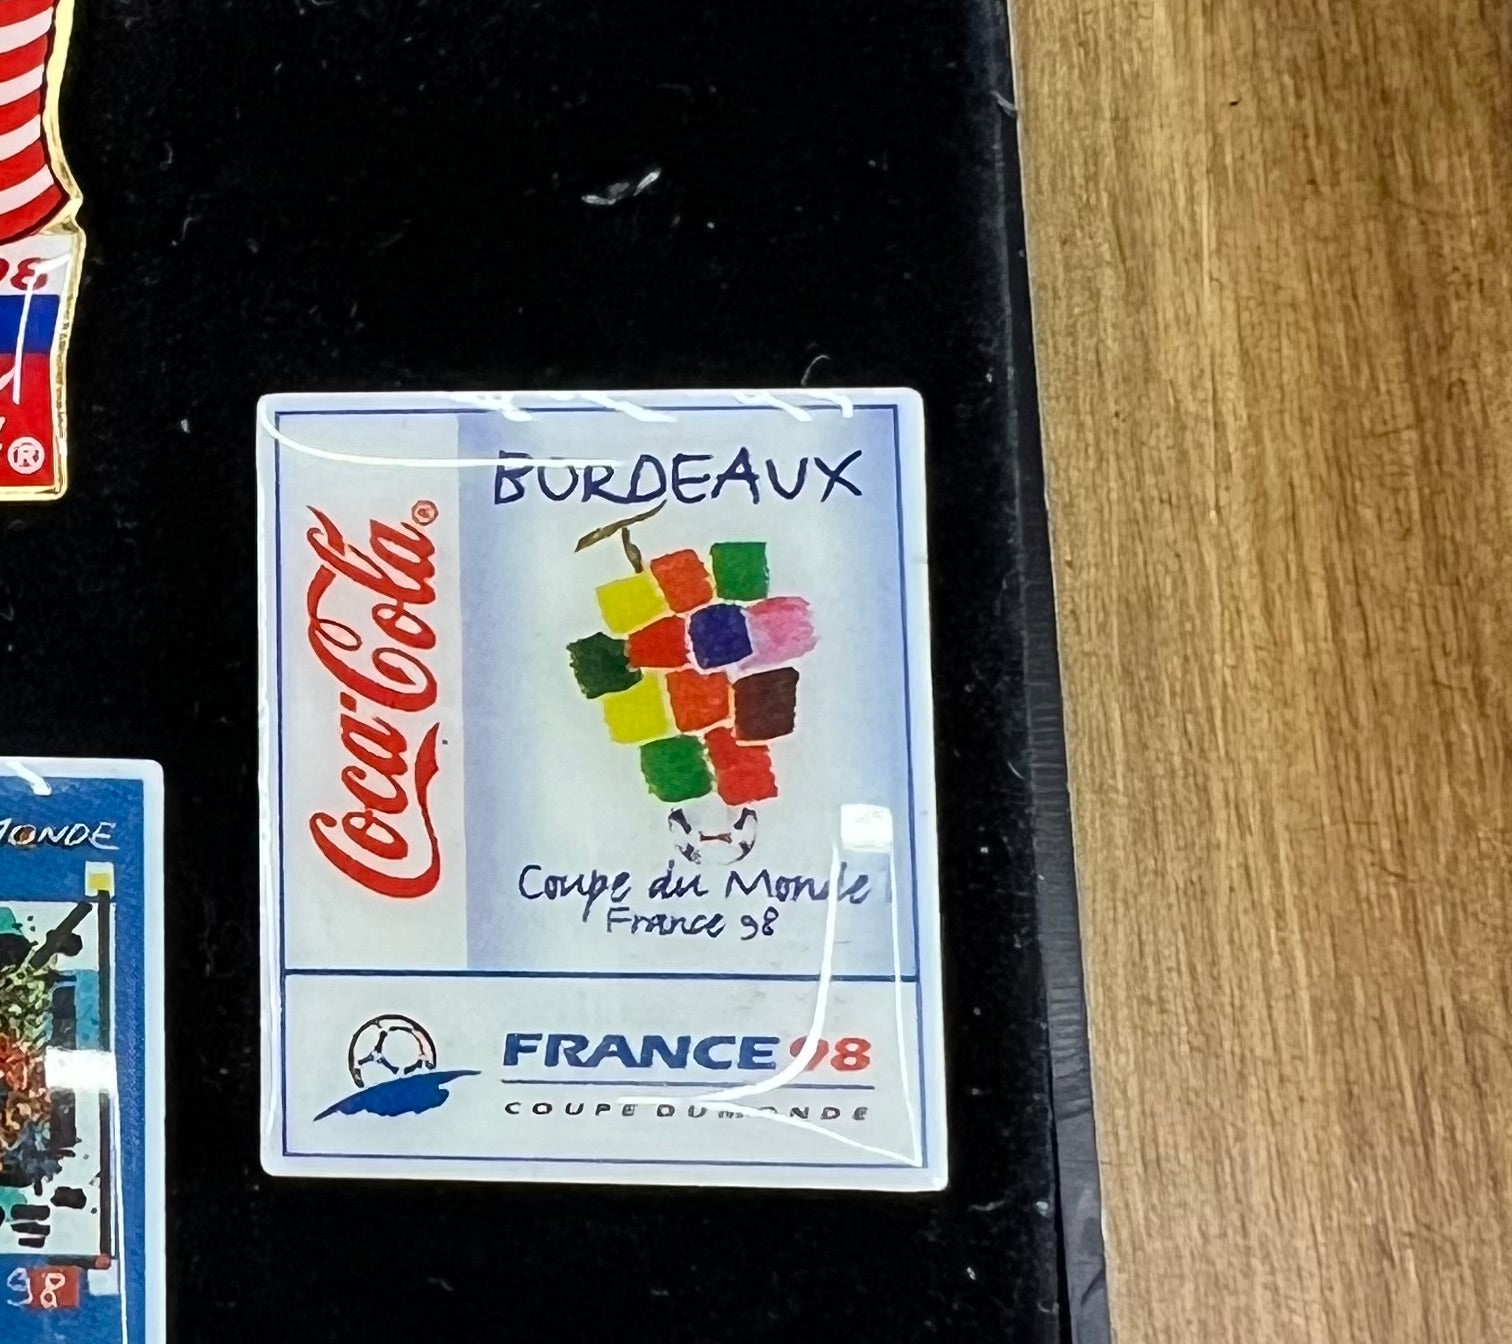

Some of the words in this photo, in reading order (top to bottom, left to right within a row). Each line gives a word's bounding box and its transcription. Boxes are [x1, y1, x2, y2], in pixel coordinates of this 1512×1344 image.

[494, 447, 863, 506] BORDEAUX
[518, 864, 632, 922] Coupe
[647, 859, 709, 900] du
[606, 906, 726, 938] France
[739, 905, 780, 940] 98
[502, 1033, 781, 1070] FRANCE
[789, 1035, 872, 1072] 98
[504, 1101, 636, 1117] COUPE
[6, 1267, 66, 1309] 98
